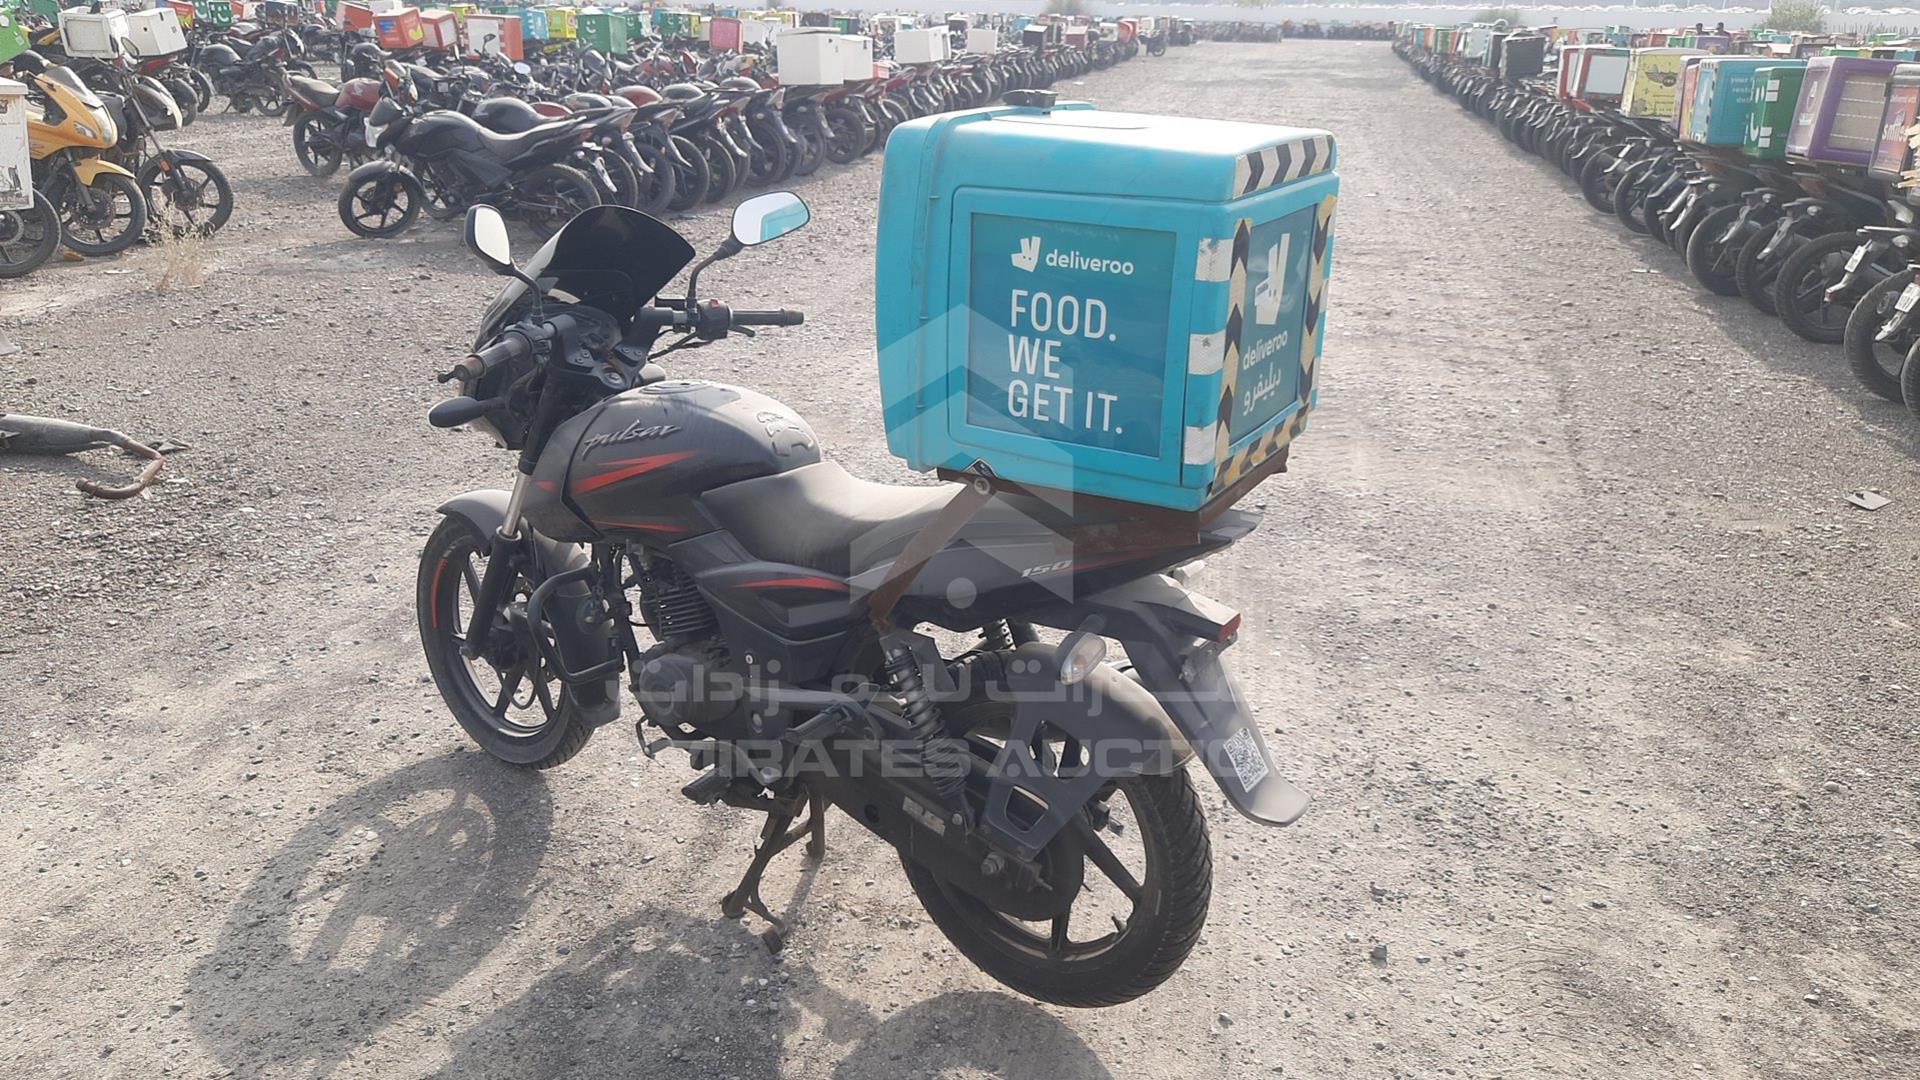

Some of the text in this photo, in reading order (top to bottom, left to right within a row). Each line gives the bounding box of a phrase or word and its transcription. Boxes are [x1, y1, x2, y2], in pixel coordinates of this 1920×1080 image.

[1045, 249, 1134, 275] deliveroo
[1010, 288, 1117, 342] FOOD.
[1008, 334, 1062, 379] WE
[1242, 330, 1289, 371] deliveroo
[1008, 379, 1122, 434] GET IT.
[1242, 362, 1282, 416] ديليفرو
[582, 419, 682, 457] pulsar
[1021, 560, 1072, 577] 150
